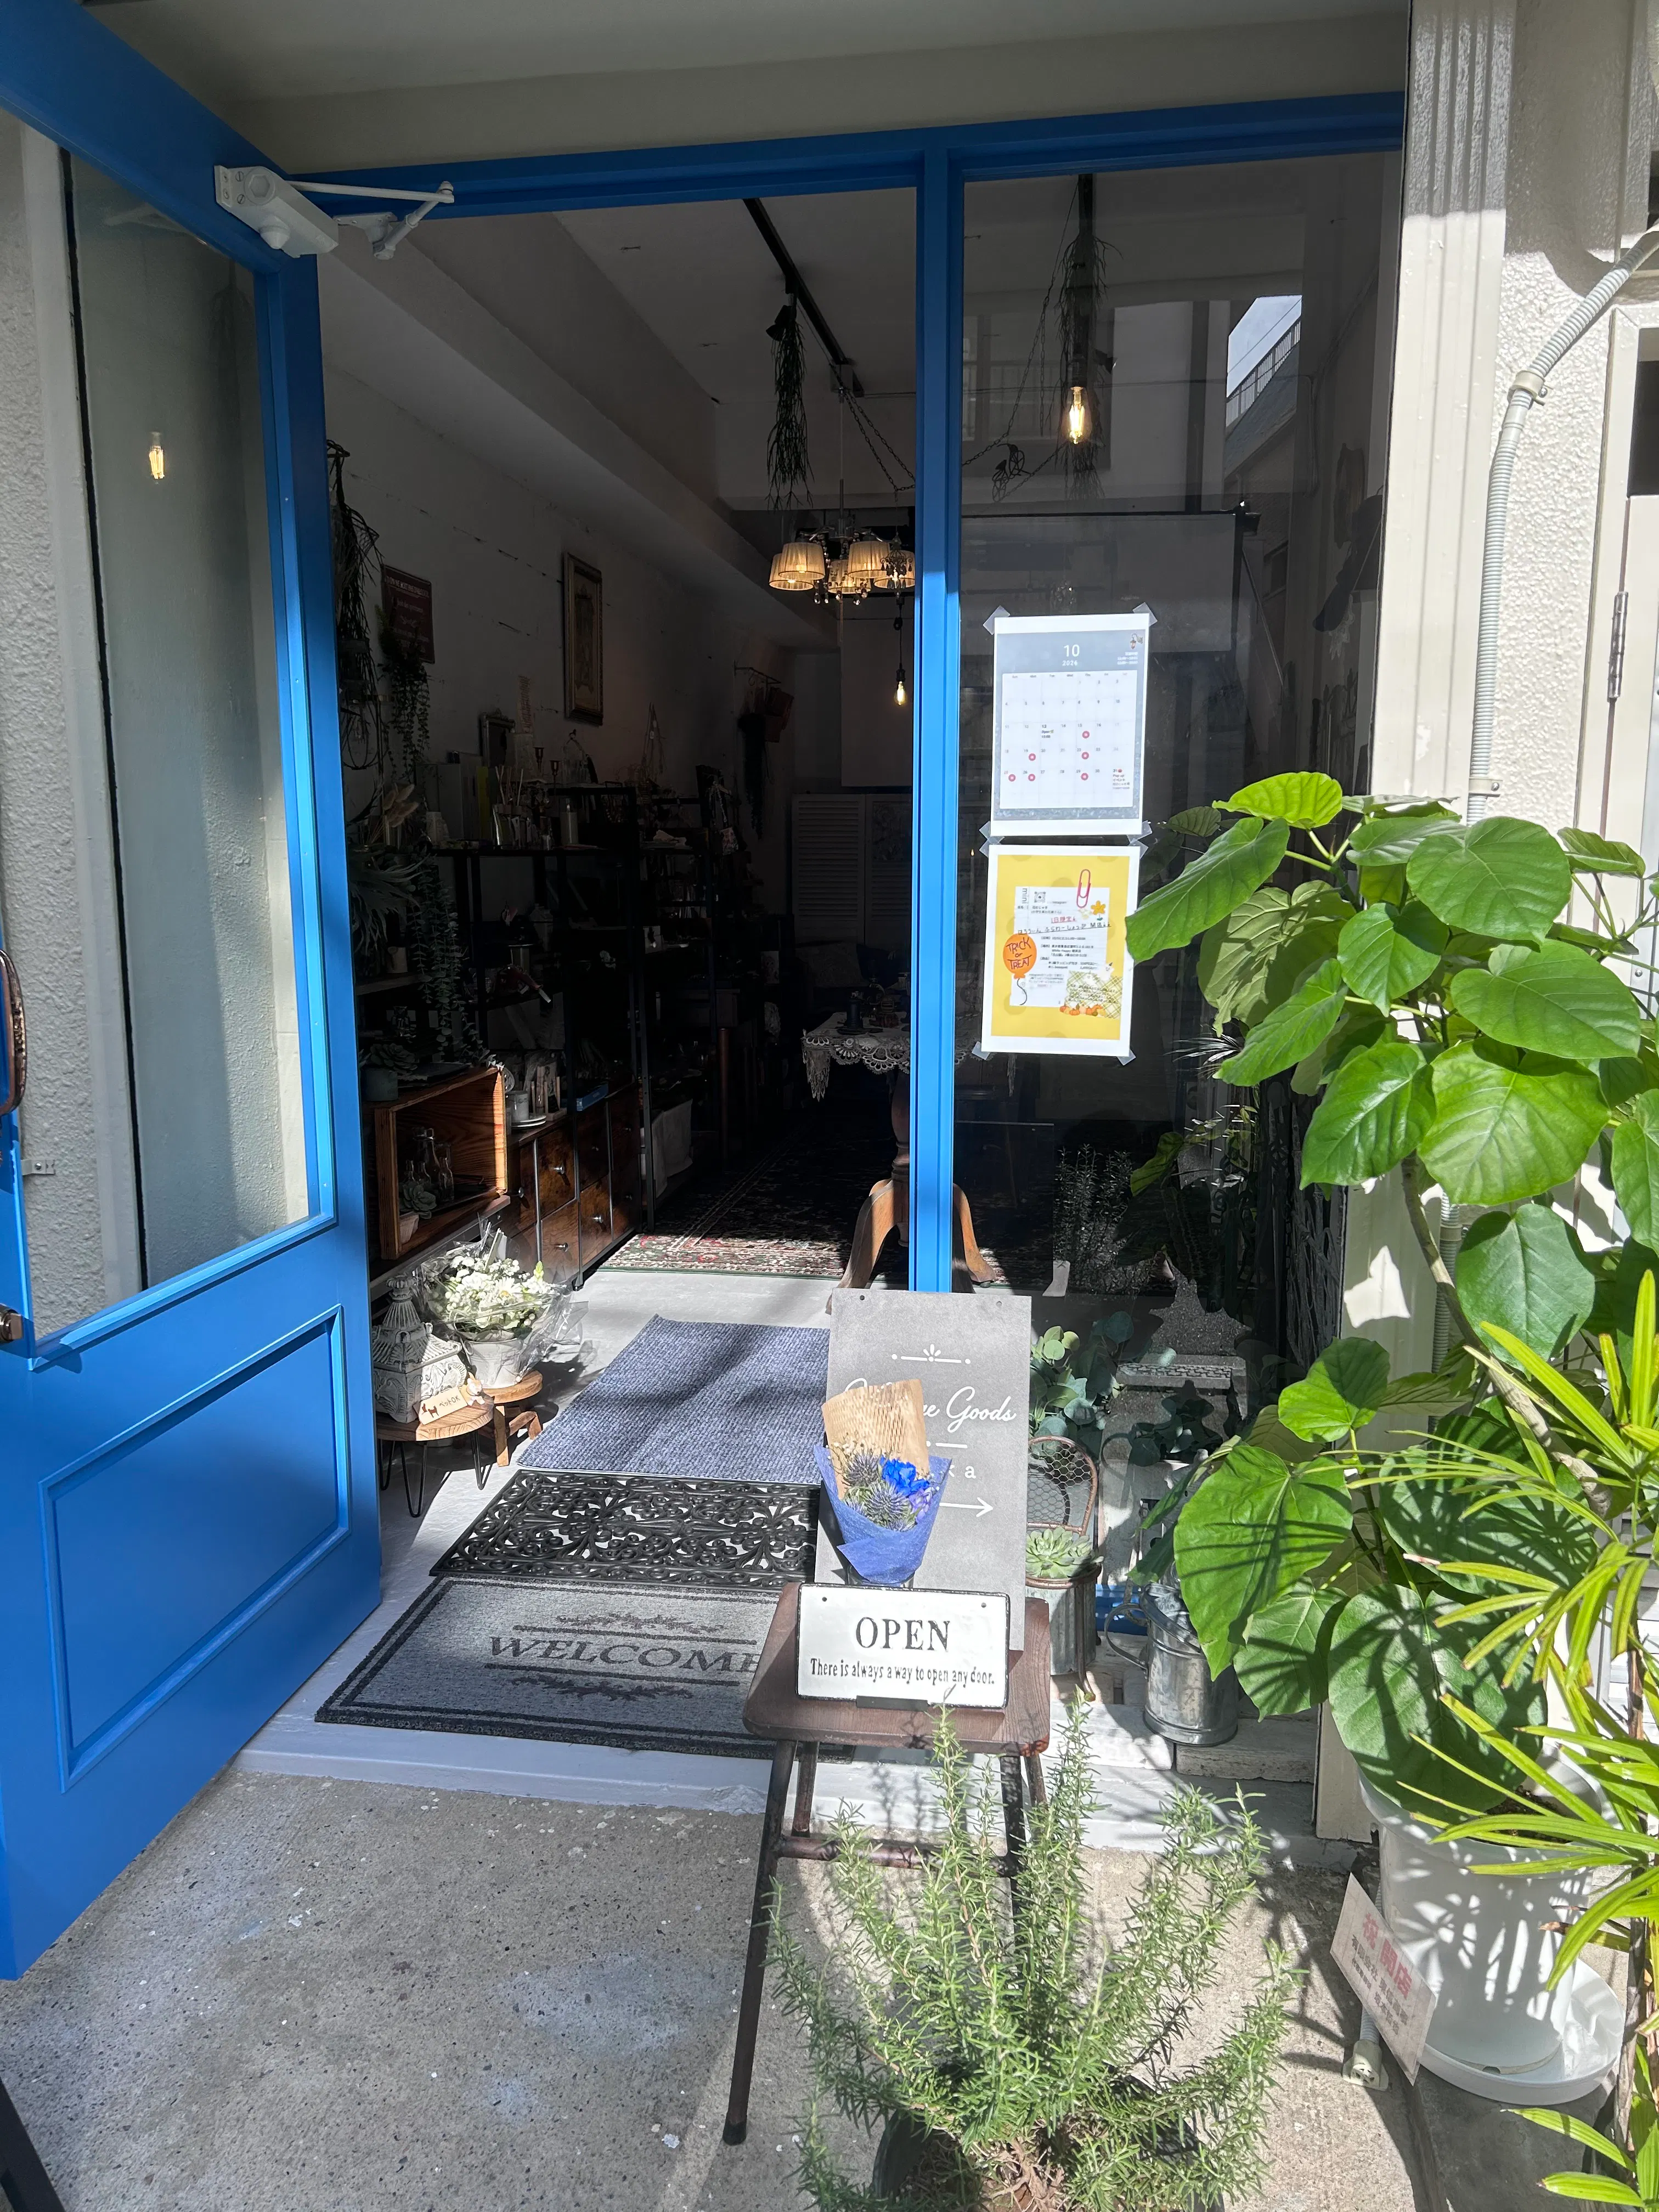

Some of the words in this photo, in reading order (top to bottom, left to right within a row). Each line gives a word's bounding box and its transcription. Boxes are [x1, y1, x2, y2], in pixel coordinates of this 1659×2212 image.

[1063, 644, 1080, 657] 10
[1006, 937, 1031, 954] TRICK
[1007, 955, 1032, 969] TREAT
[439, 1395, 461, 1407] ペットOK
[946, 1386, 1017, 1432] Goods
[856, 1617, 950, 1652] OPEN
[490, 1636, 761, 1673] WELCOME
[810, 1658, 838, 1677] There
[840, 1660, 849, 1677] is
[851, 1661, 883, 1683] always
[887, 1667, 892, 1679] a
[895, 1667, 912, 1684] way
[916, 1666, 924, 1680] to
[927, 1669, 949, 1685] open
[952, 1669, 968, 1688] any
[970, 1666, 995, 1684] door.
[1352, 1934, 1378, 1983] 有限会社
[1380, 1939, 1412, 2000] 開店
